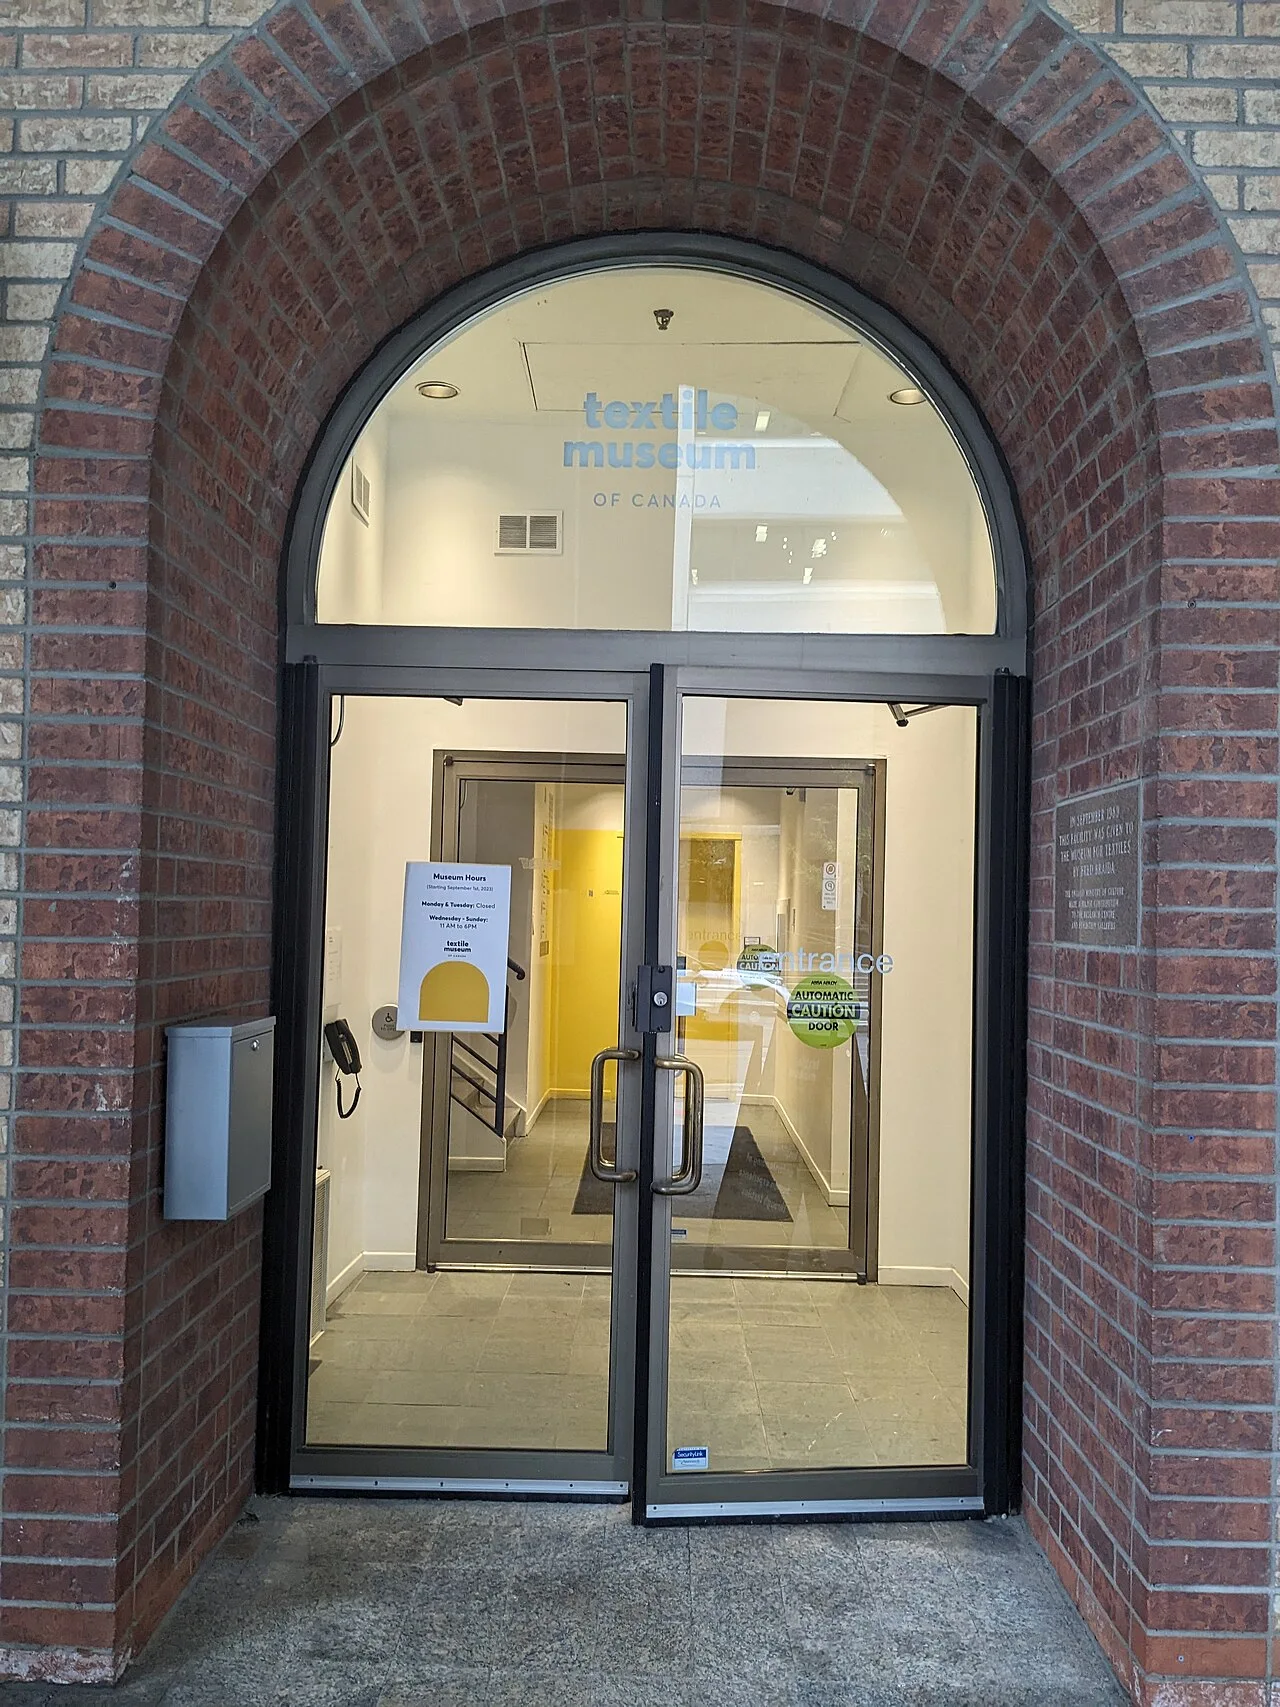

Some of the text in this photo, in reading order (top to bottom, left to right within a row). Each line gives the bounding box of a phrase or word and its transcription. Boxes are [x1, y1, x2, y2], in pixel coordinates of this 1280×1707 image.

[583, 389, 738, 430] textile
[563, 441, 756, 469] museum
[594, 493, 721, 508] OF CANADA
[1125, 821, 1134, 835] TO
[1105, 840, 1131, 856] TEXTILES
[433, 873, 486, 882] Museum Hours
[446, 940, 469, 948] textile
[759, 947, 894, 974] entrance
[795, 991, 853, 1001] AUTOMATIC
[791, 1003, 857, 1018] CAUTION
[808, 1022, 839, 1031] DOOR
